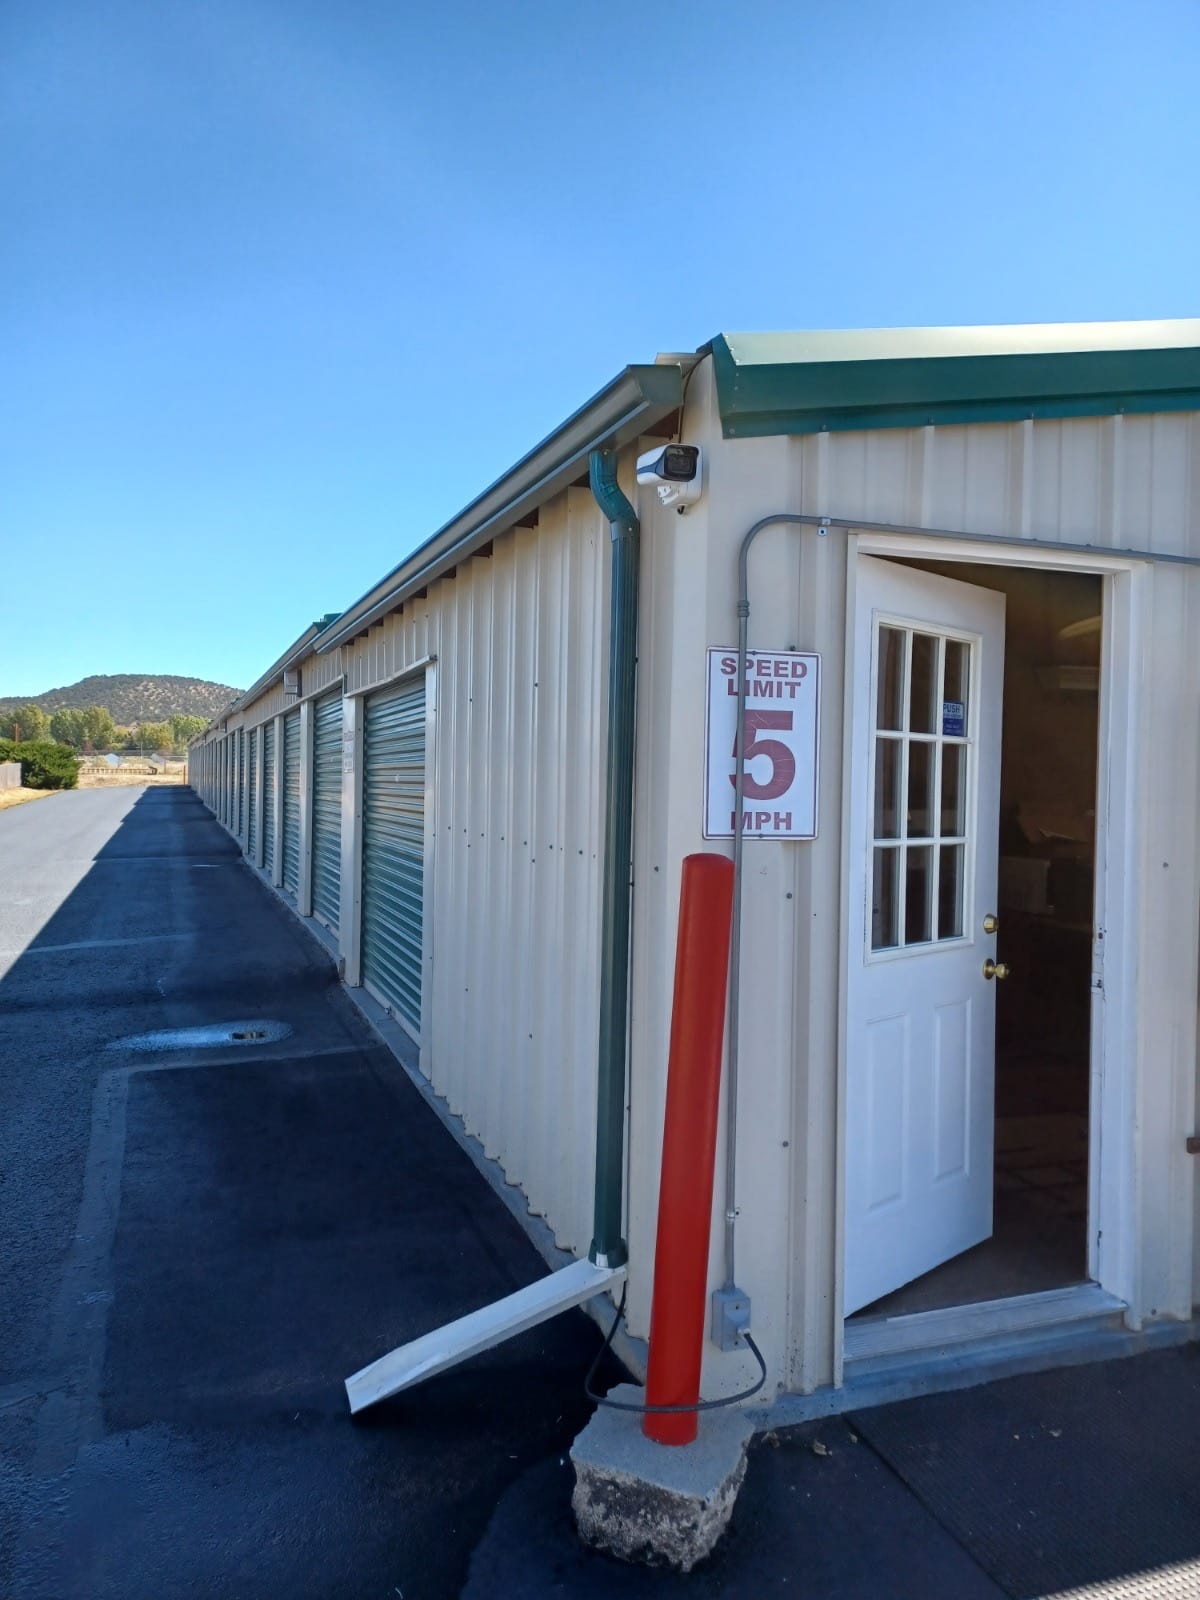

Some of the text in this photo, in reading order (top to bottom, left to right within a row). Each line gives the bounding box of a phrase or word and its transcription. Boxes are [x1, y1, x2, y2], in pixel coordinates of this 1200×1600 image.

[727, 679, 801, 699] LIMIT
[729, 709, 796, 801] 5
[731, 811, 792, 831] MPH
